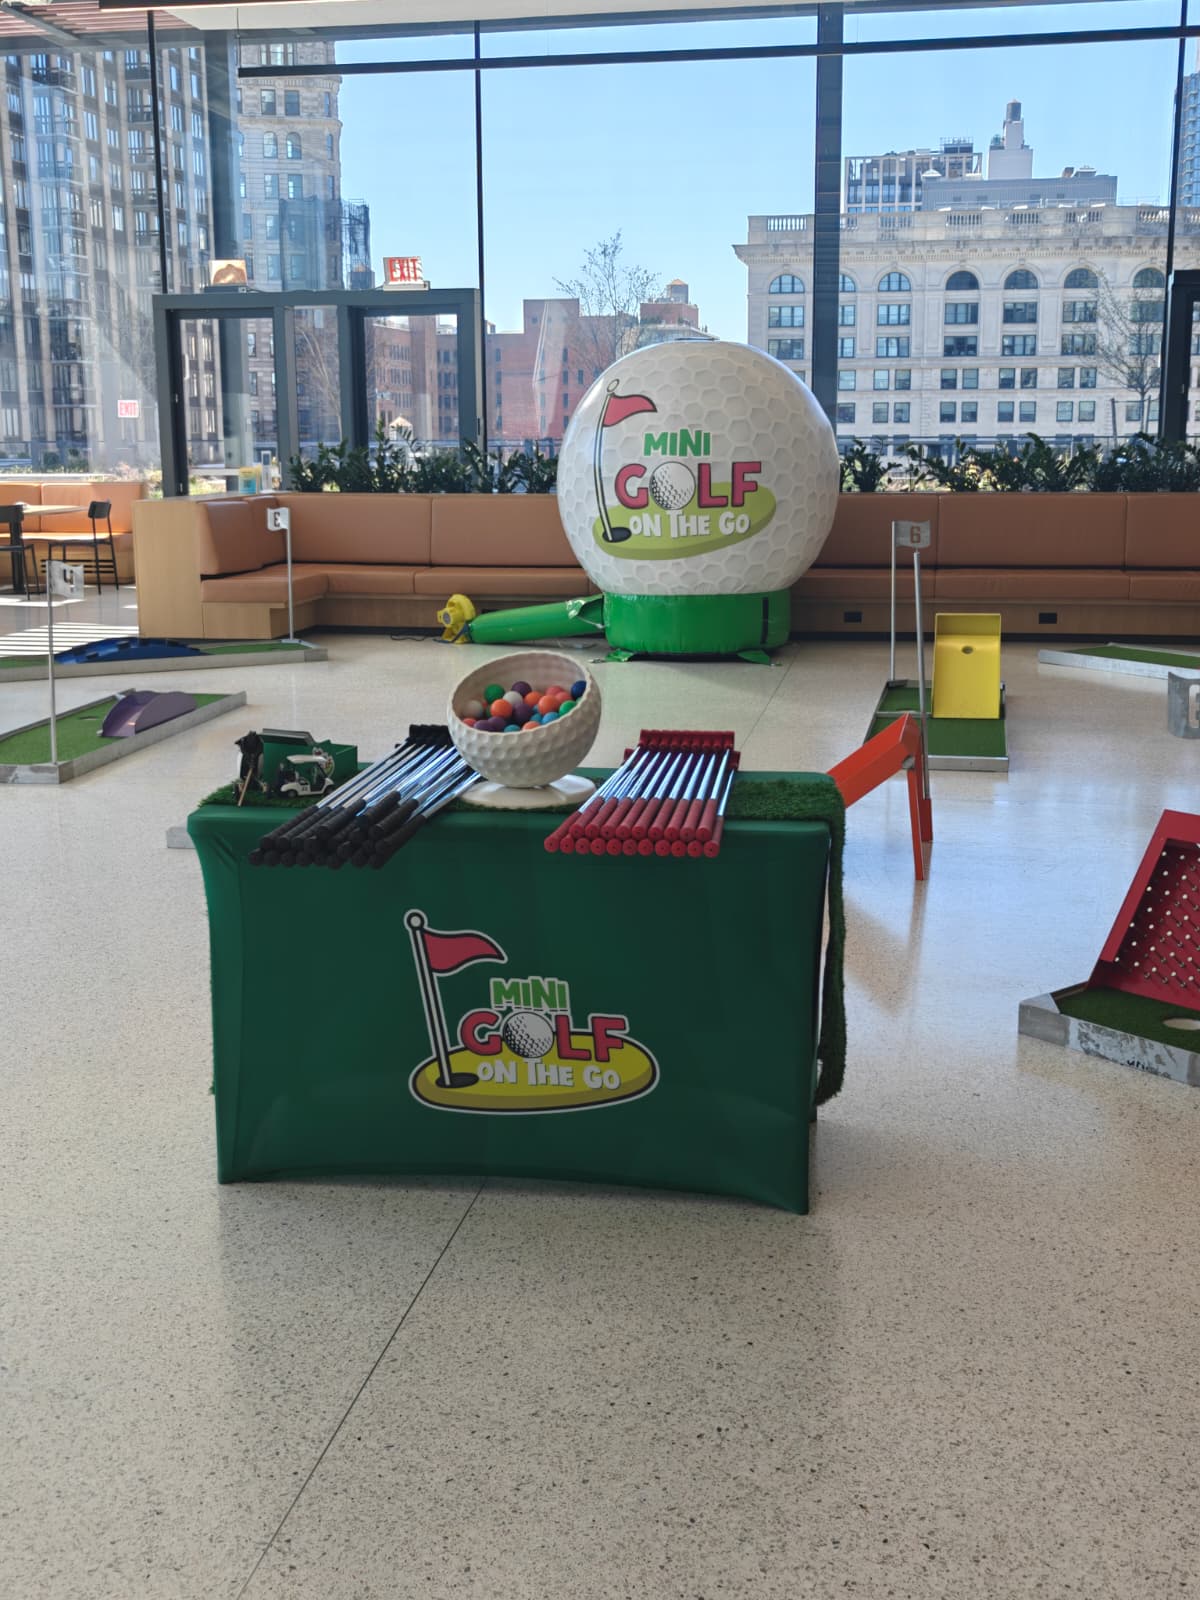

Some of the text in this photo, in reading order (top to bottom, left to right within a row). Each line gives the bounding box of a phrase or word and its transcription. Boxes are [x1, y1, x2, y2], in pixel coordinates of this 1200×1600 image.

[388, 257, 418, 282] EXIT
[643, 428, 711, 457] MINI
[614, 461, 762, 510] GOLF
[629, 509, 751, 538] ON THE GO
[910, 526, 921, 544] 6
[491, 977, 569, 1010] MINI
[460, 1010, 627, 1062] GOLF
[477, 1057, 621, 1090] ON THE GO
